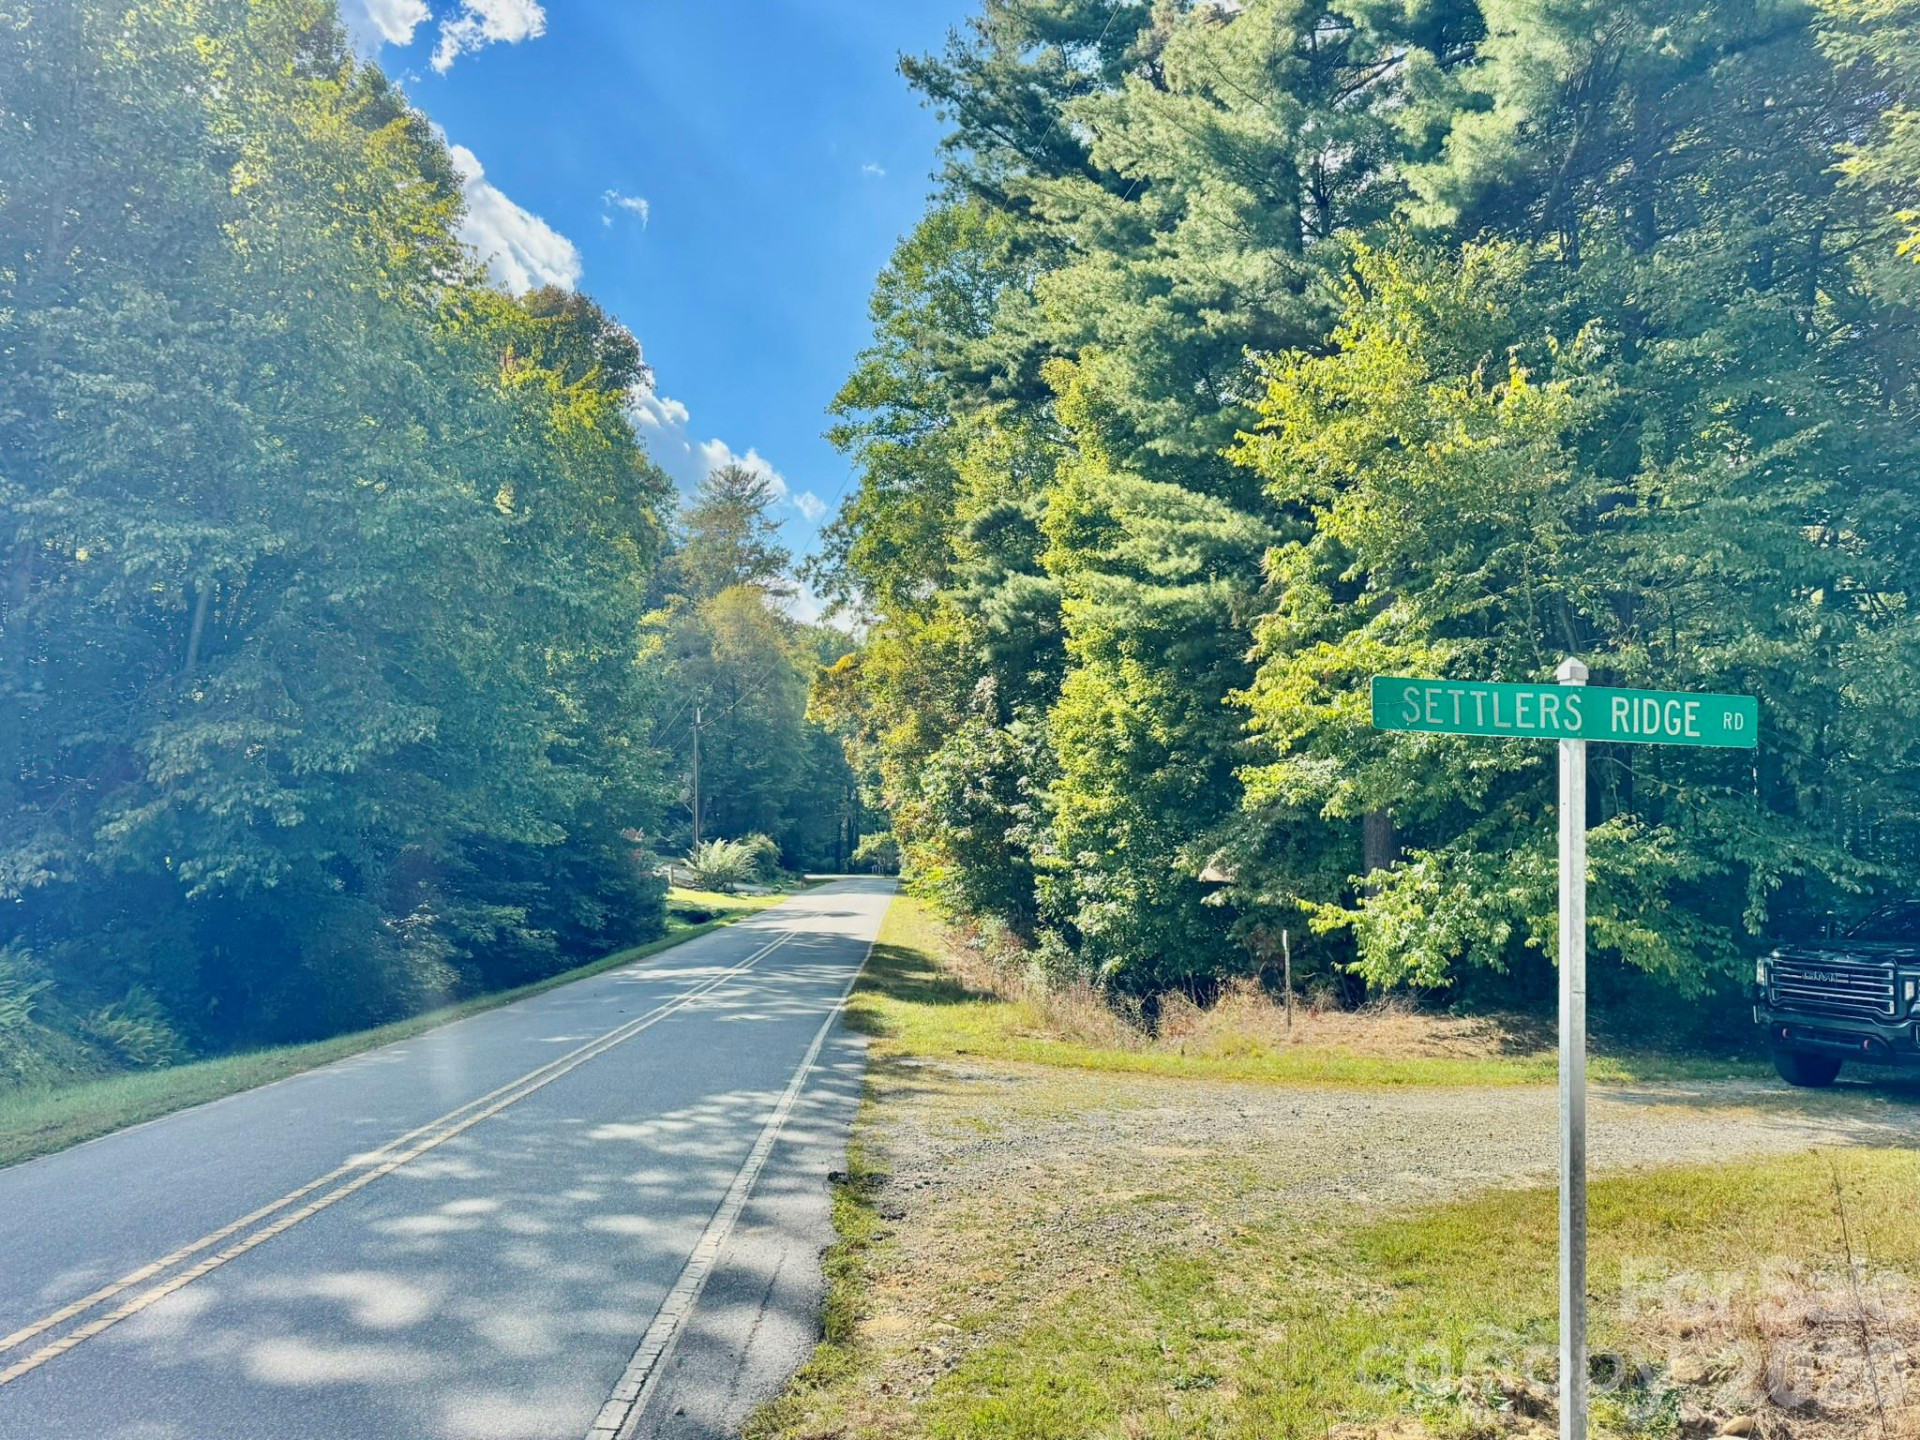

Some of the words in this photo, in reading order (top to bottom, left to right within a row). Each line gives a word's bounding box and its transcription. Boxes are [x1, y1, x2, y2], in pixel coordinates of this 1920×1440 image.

[1401, 686, 1583, 731] SETTLERS
[1611, 696, 1700, 736] RIDGE
[1723, 712, 1744, 730] RD
